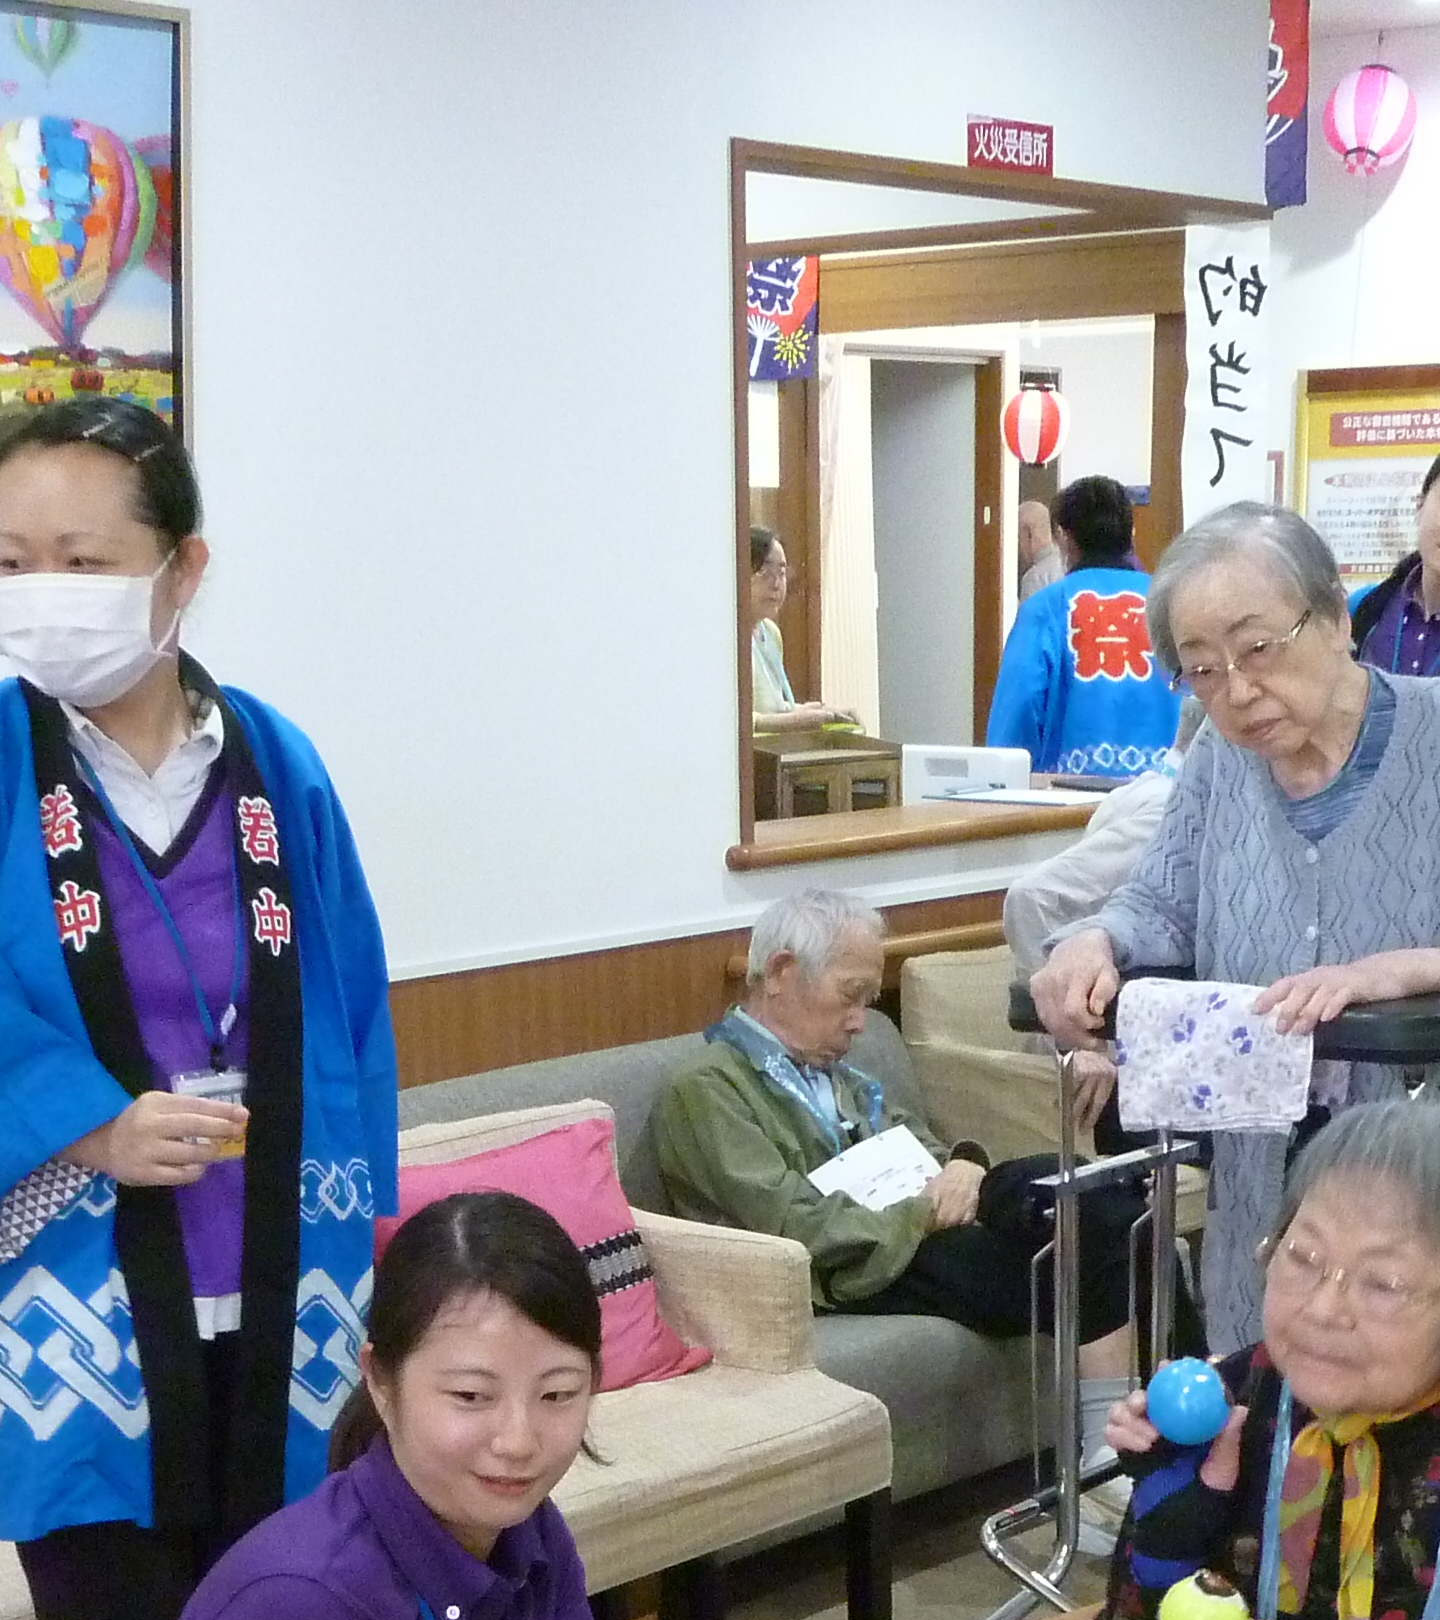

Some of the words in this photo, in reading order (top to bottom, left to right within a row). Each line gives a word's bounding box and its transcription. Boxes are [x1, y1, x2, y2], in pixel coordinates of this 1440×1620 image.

[973, 124, 1048, 168] 火災受信所
[1067, 590, 1153, 681] 祭
